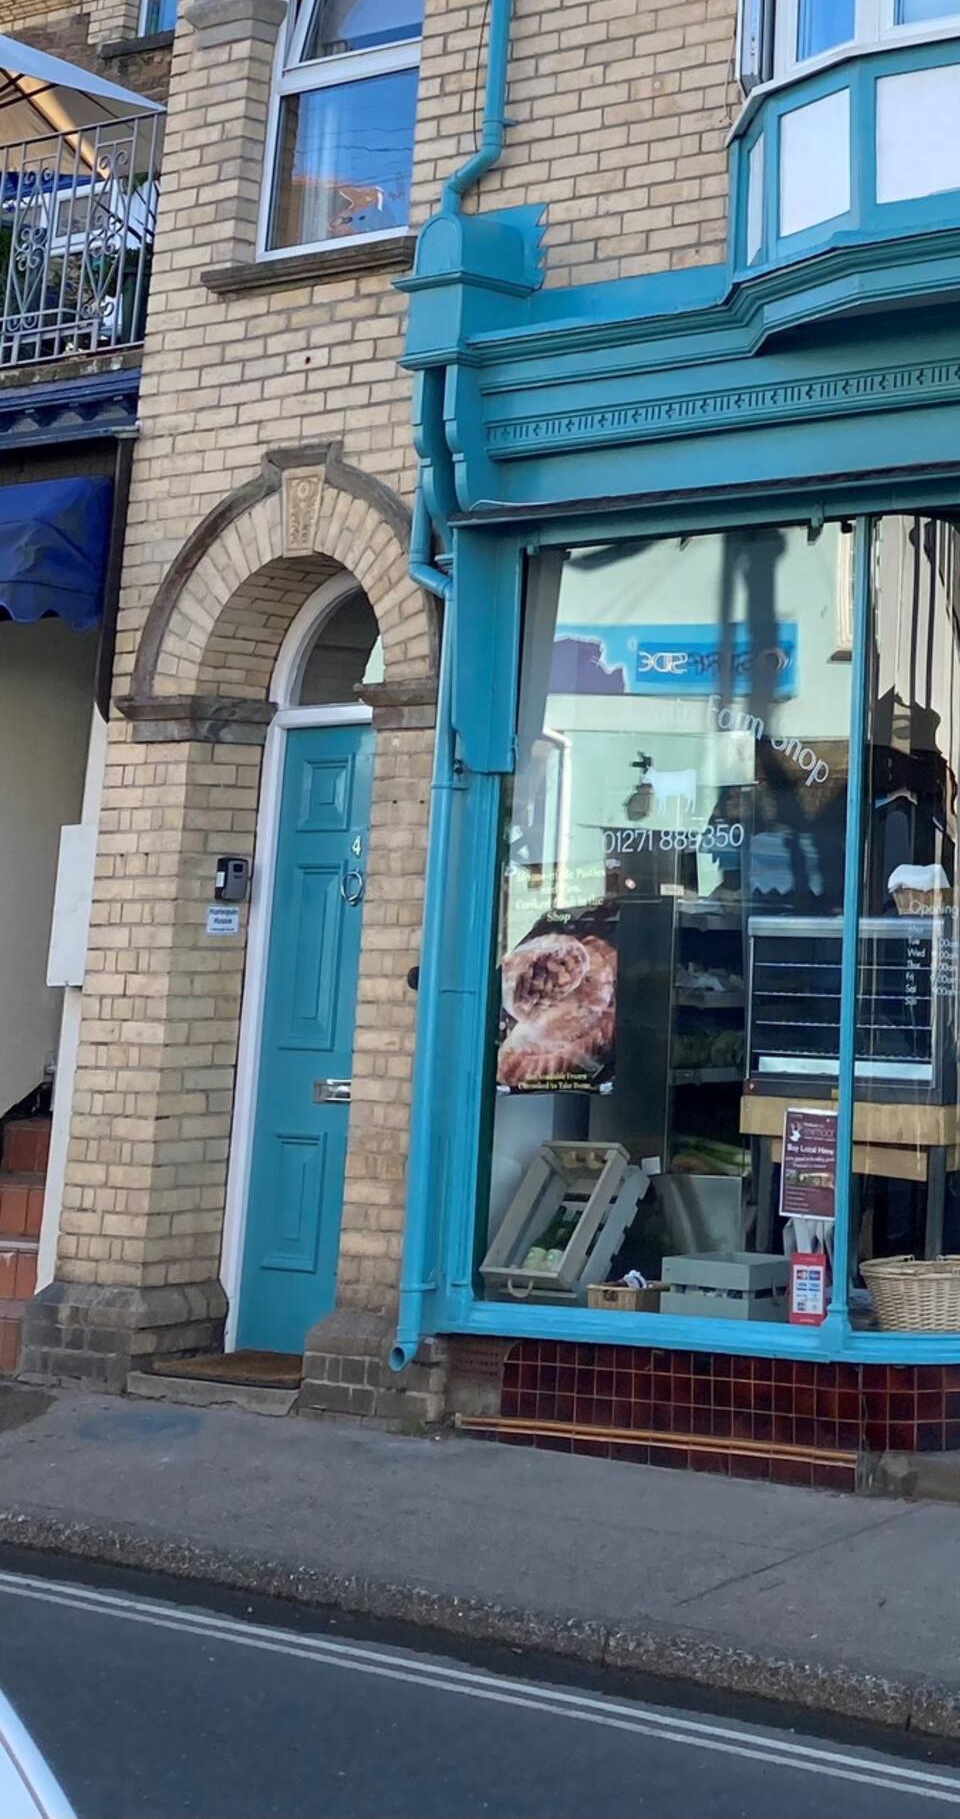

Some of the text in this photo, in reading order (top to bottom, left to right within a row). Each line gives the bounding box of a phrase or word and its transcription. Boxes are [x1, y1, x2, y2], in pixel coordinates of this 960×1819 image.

[352, 836, 362, 856] 4
[602, 823, 745, 854] 01271 889350
